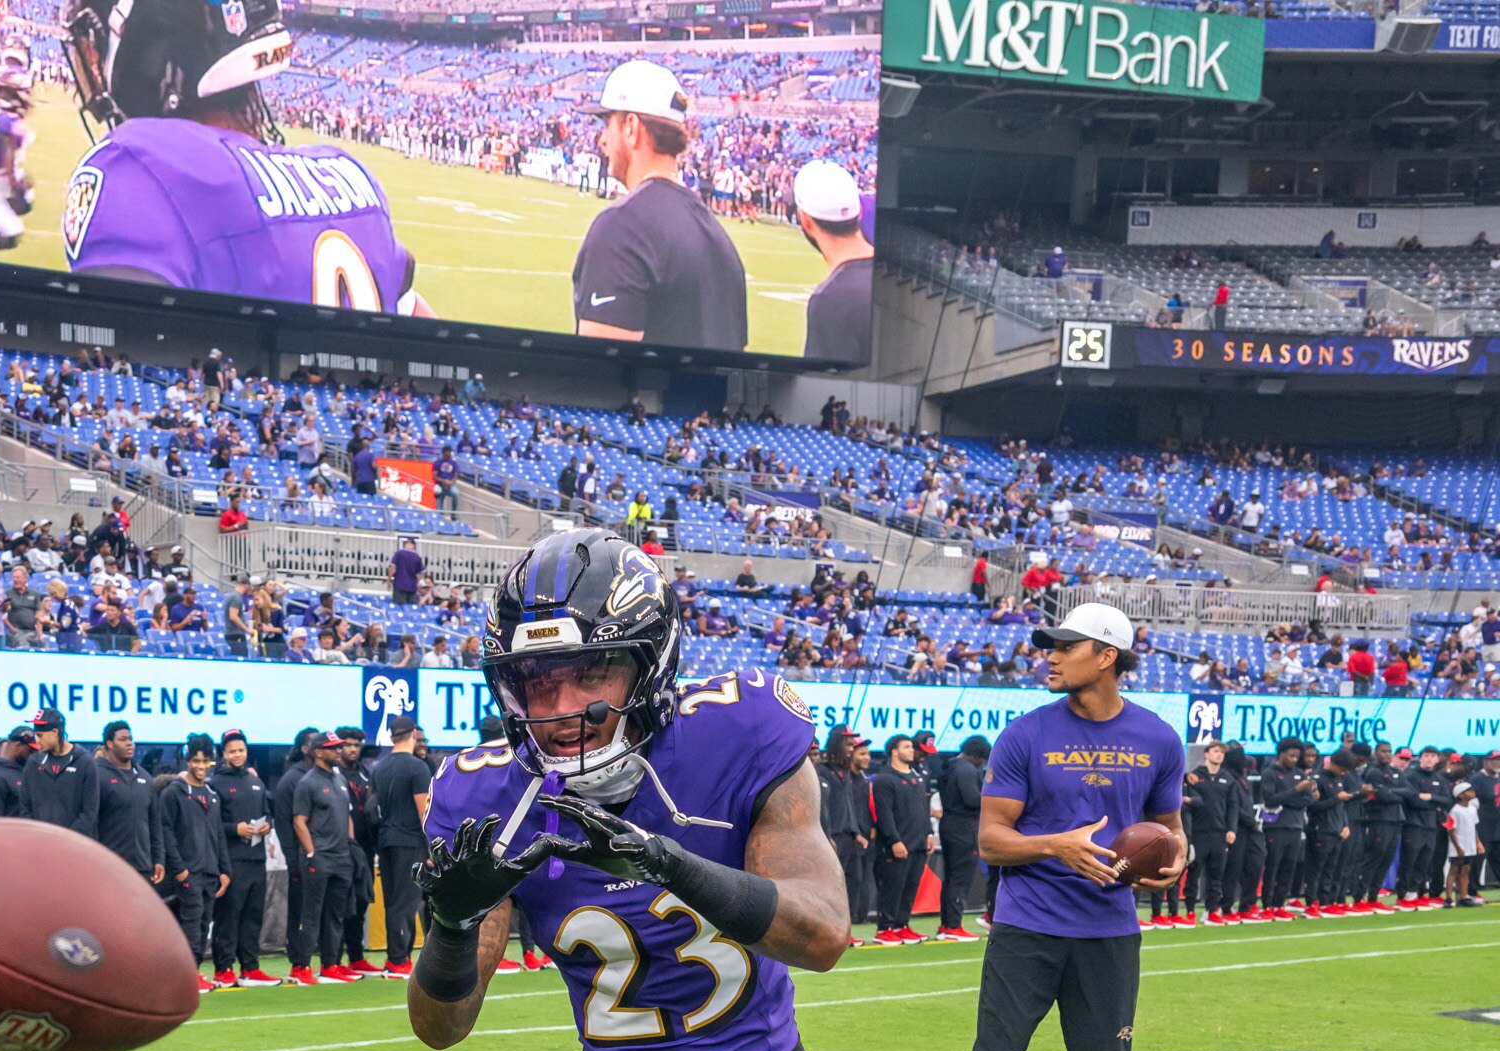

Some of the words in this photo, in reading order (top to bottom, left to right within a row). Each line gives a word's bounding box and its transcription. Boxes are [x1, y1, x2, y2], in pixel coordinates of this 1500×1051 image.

[922, 0, 1084, 75] M&T
[1086, 5, 1231, 92] Bank
[1448, 25, 1481, 48] TEXT
[239, 147, 381, 218] JACKSON
[1067, 328, 1105, 361] 25
[1171, 338, 1205, 361] 30
[1223, 341, 1355, 366] SEASONS
[1392, 338, 1471, 370] RAVENS
[526, 626, 560, 640] RAVENS
[592, 630, 624, 643] OAKLEY
[811, 705, 854, 727] EST
[870, 707, 936, 729] WITH
[1042, 751, 1152, 768] RAVENS
[1064, 744, 1134, 752] BALTIMORE
[603, 879, 646, 893] RAV
[552, 889, 756, 1044] 23
